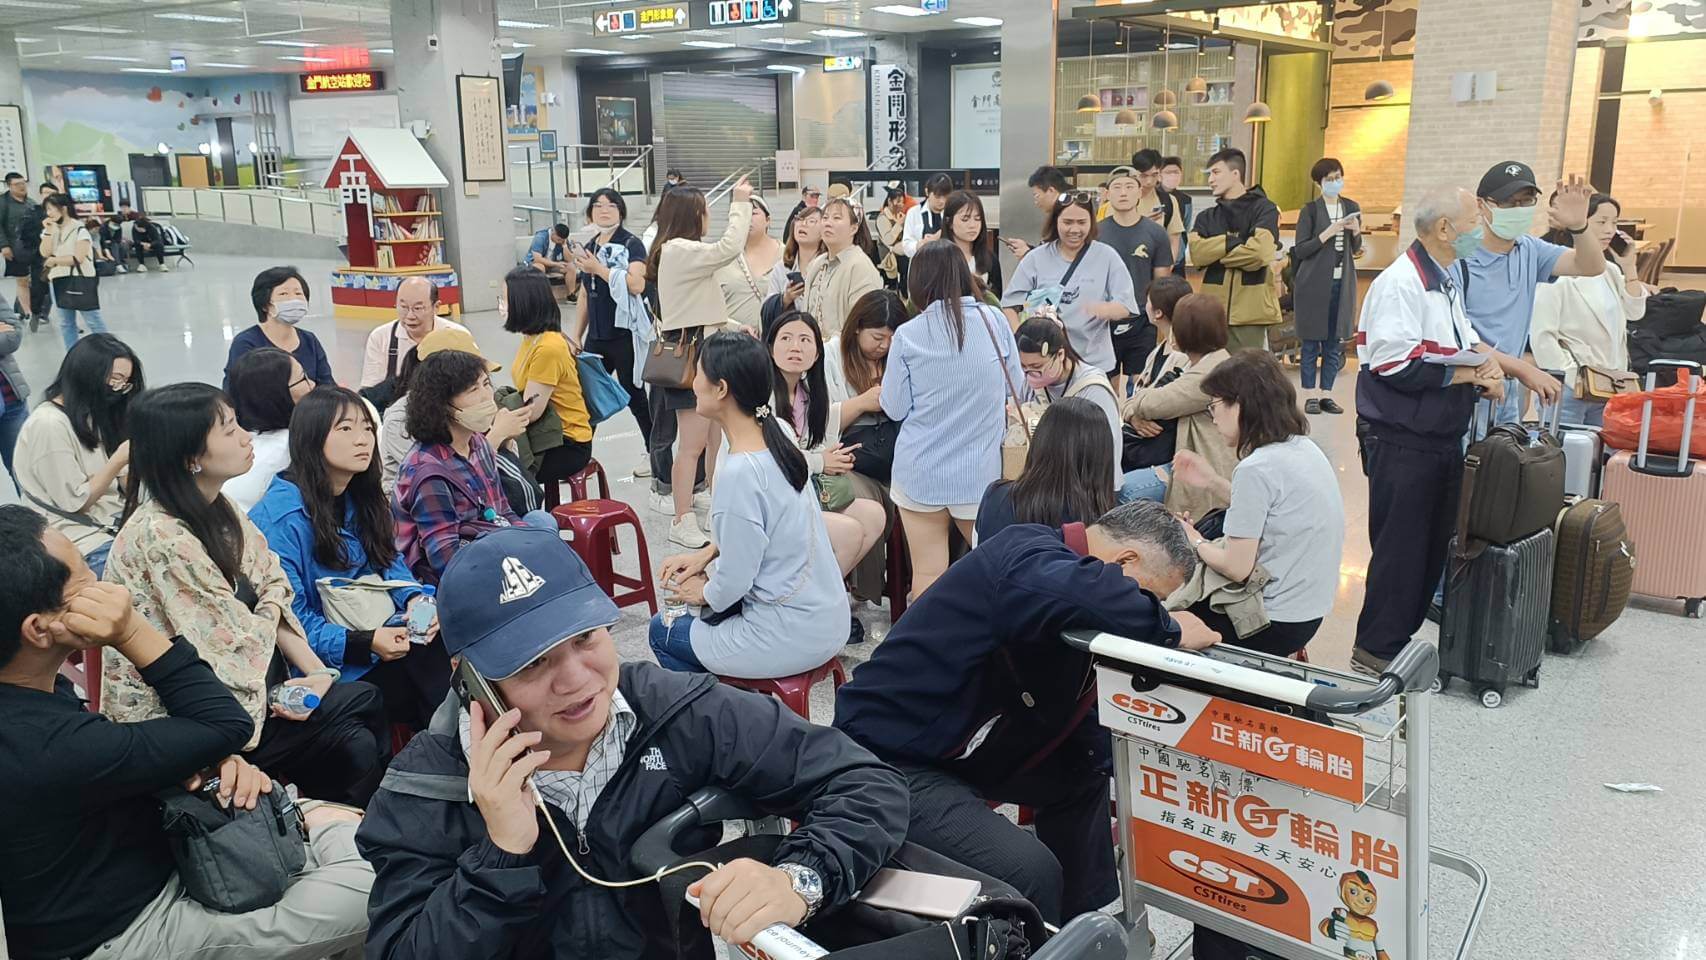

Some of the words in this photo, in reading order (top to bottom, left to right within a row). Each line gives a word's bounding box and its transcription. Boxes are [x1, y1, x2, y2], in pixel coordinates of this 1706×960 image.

[1112, 693, 1168, 717] CST
[1128, 716, 1161, 731] CSTtires
[646, 762, 668, 770] FACE
[1168, 850, 1260, 893] CST
[1194, 885, 1247, 912] CSTtires
